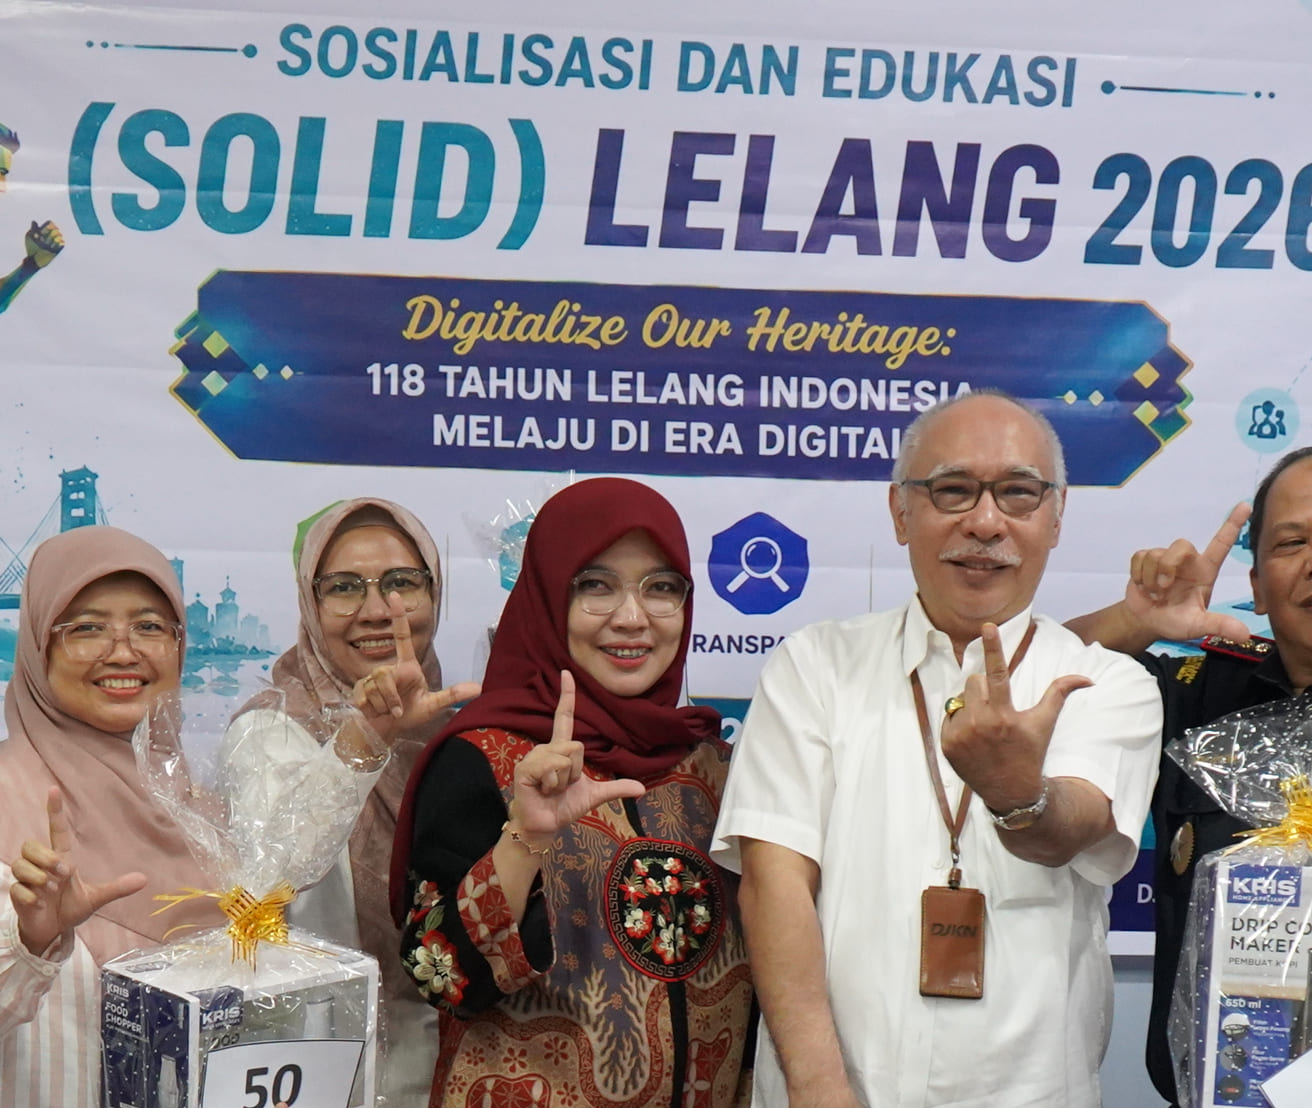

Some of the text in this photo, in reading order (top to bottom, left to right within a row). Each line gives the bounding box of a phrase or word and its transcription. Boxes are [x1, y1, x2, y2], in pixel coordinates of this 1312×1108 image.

[277, 23, 1077, 107] SOSIALISASI DAN EDUKASI
[67, 101, 546, 250] (SOLID)
[584, 128, 1060, 263] LELANG
[402, 294, 958, 370] Digitalize Our Heritage:
[366, 363, 425, 397] 118
[439, 364, 572, 402] TAHUN
[588, 370, 745, 407] LELANG
[432, 414, 596, 453] MELAJU
[610, 419, 649, 453] DI
[664, 421, 744, 456] ERA
[1232, 877, 1297, 896] KRIS
[931, 923, 978, 937] DJKN
[1232, 917, 1278, 933] DRIP
[1230, 936, 1300, 954] MAKER
[1229, 957, 1273, 967] PEMBUAT
[106, 1001, 128, 1017] FOOD
[1248, 1000, 1262, 1009] ml
[105, 1012, 142, 1034] CHOPPER
[202, 1006, 241, 1025] KRIS
